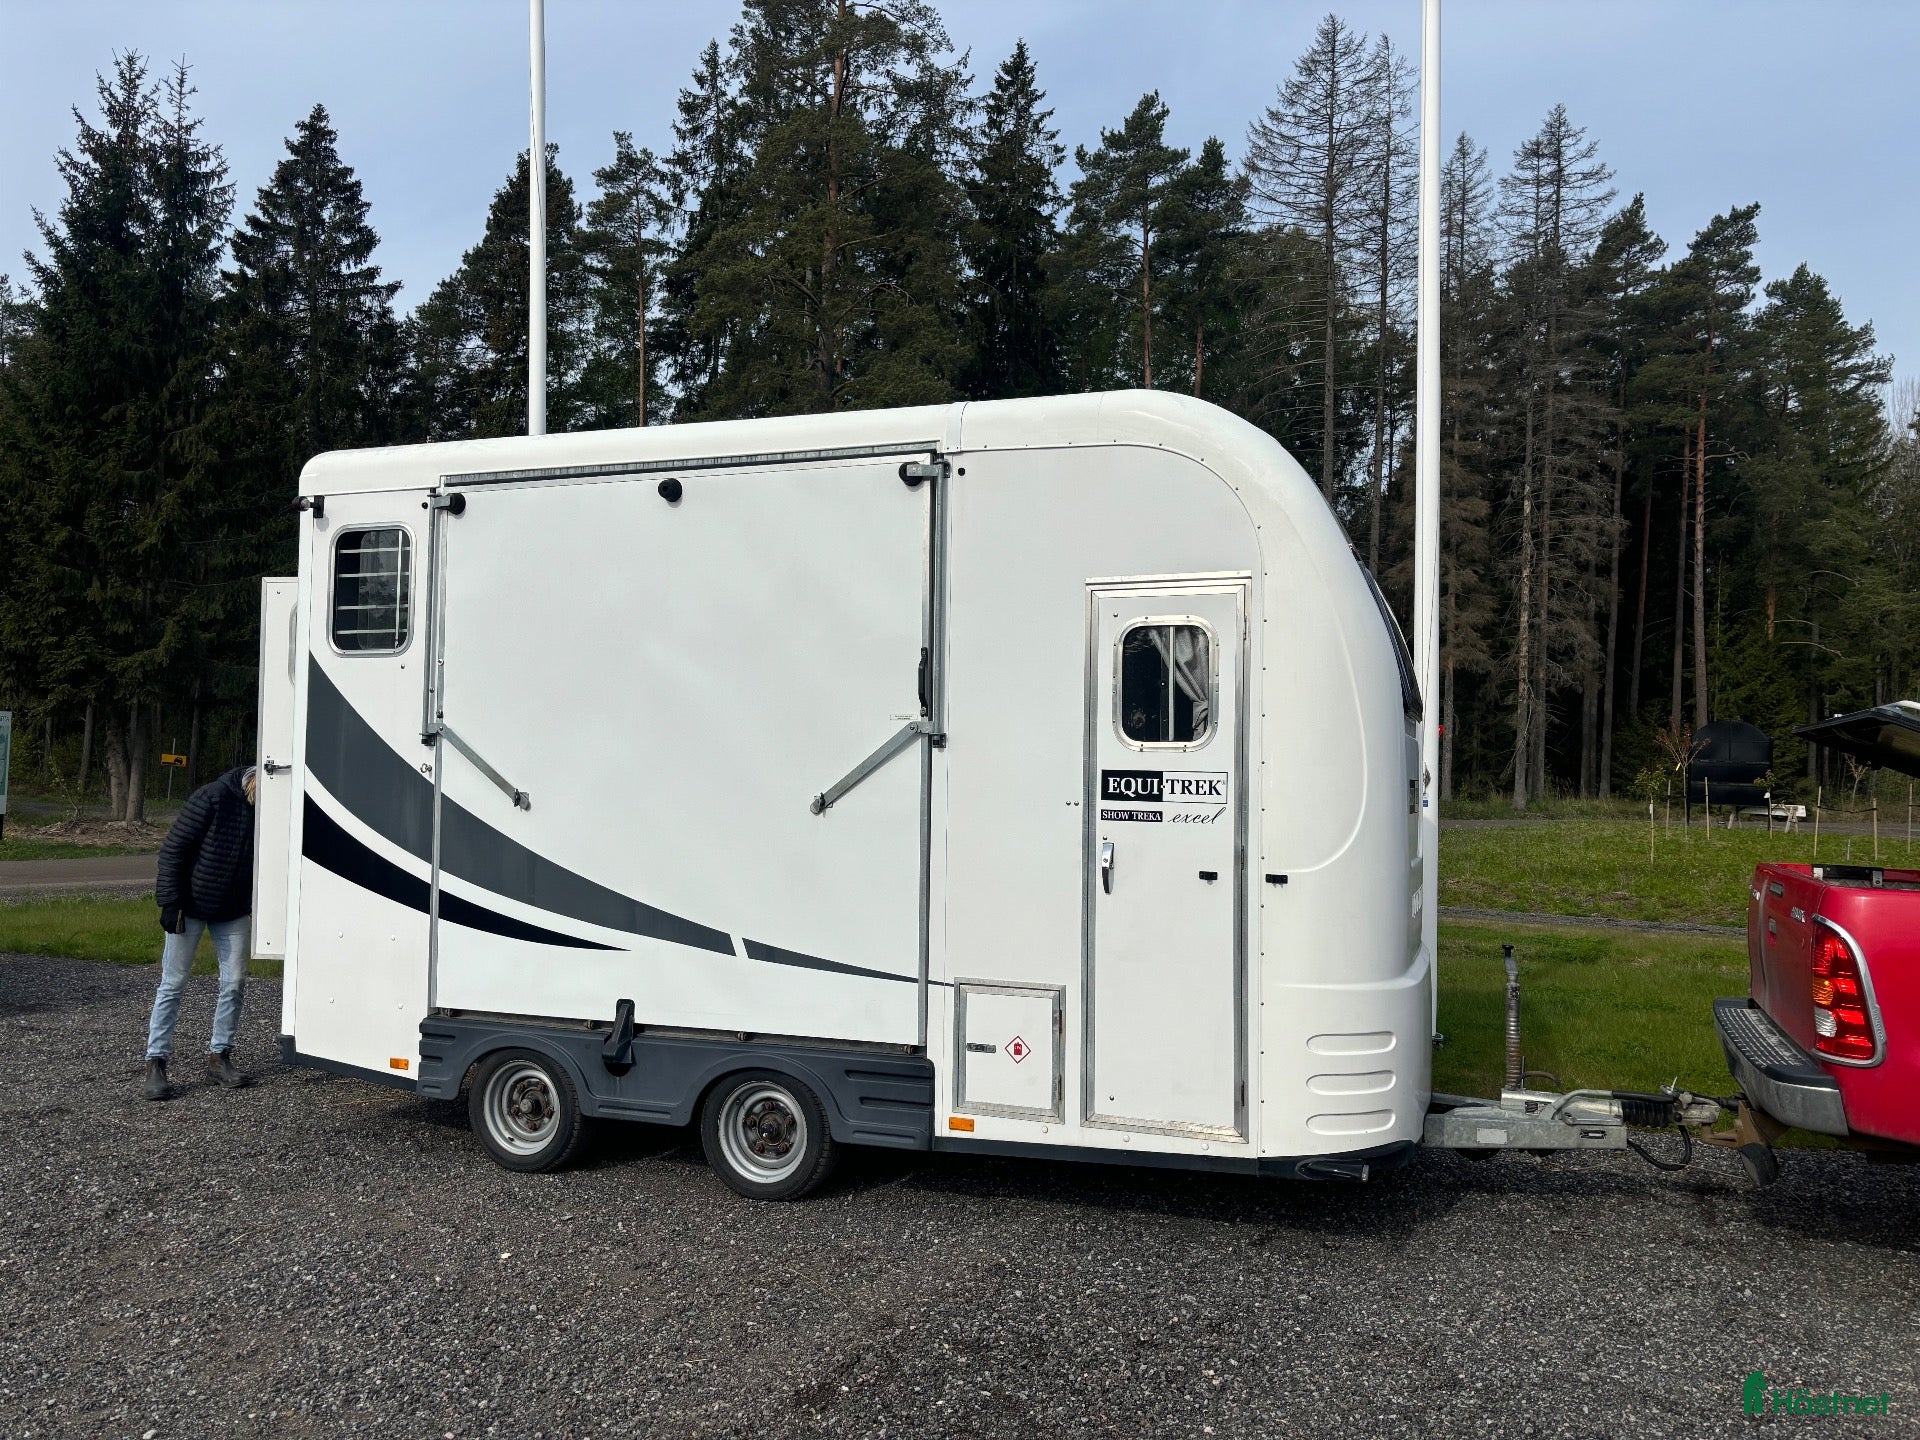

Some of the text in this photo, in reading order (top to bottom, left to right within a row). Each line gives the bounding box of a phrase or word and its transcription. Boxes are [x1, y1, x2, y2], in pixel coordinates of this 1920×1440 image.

[1102, 806, 1227, 825] SHOW TREKA excel
